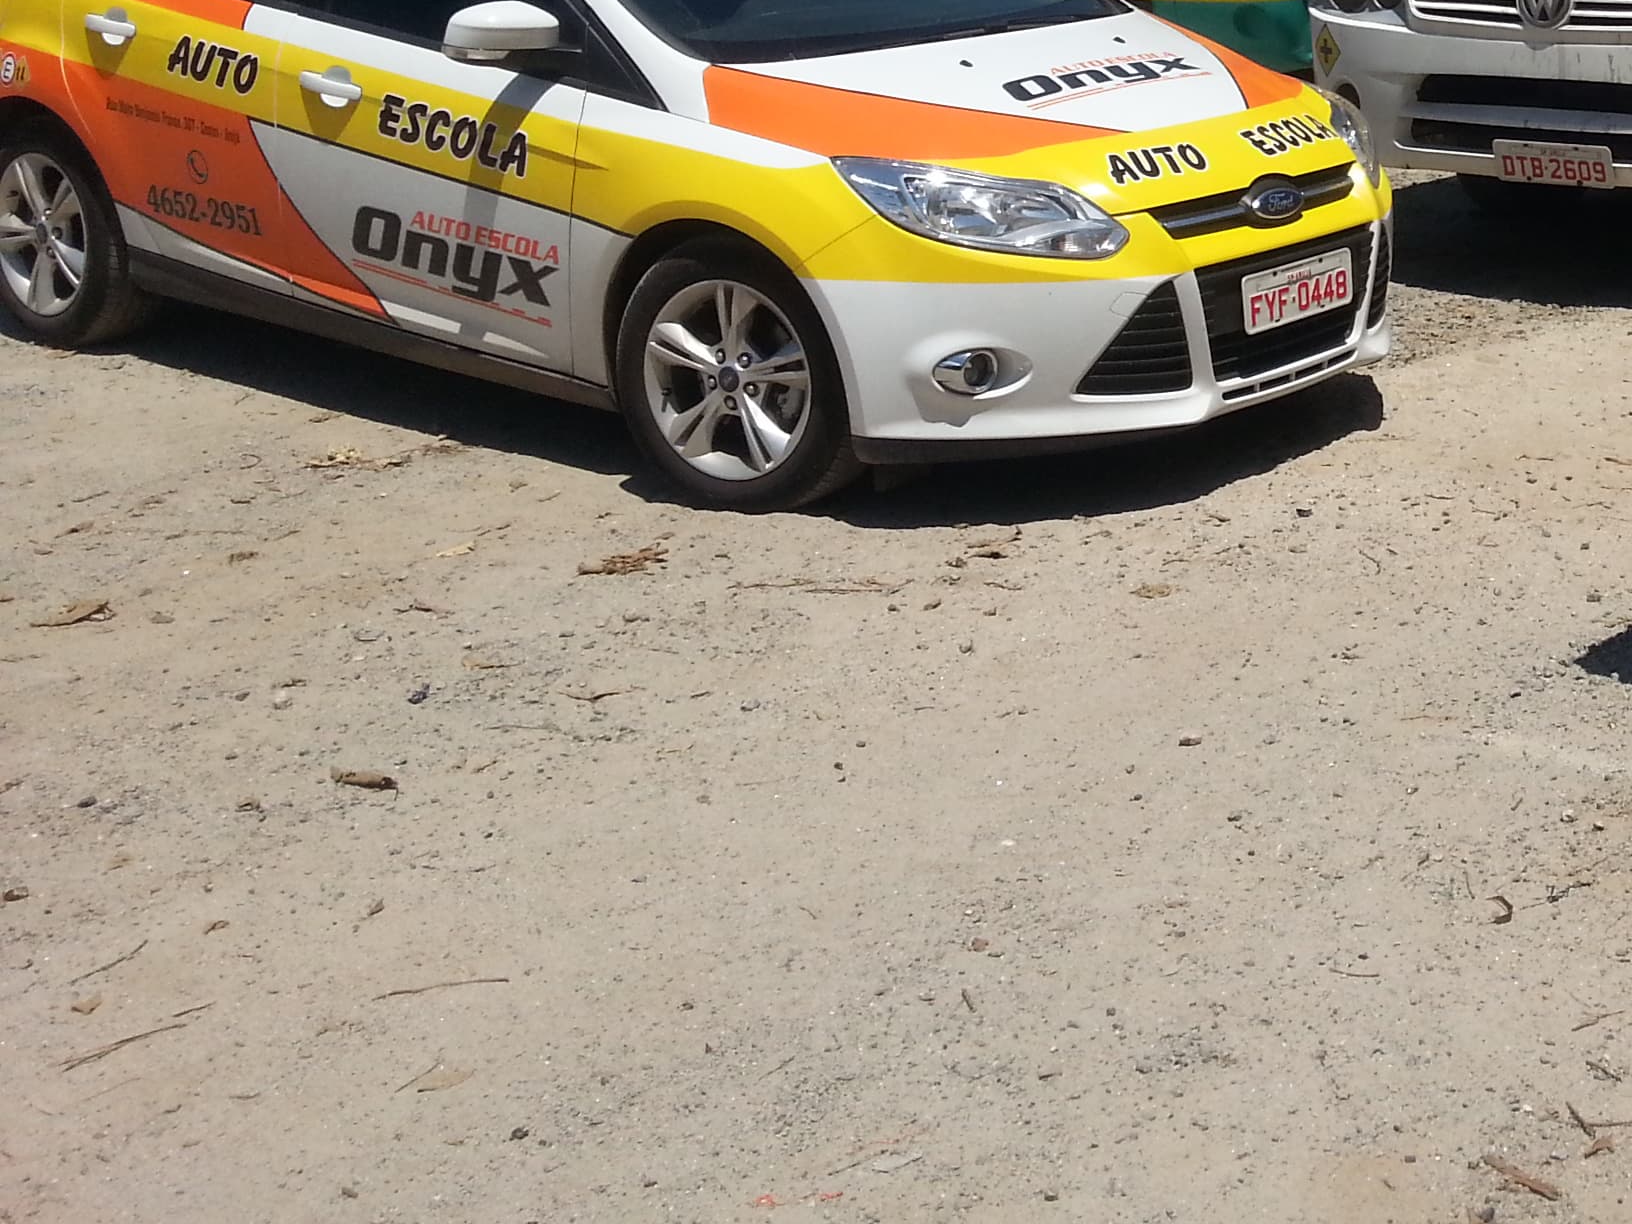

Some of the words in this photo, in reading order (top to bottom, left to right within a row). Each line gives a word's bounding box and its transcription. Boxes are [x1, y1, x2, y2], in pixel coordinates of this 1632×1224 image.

[167, 35, 258, 94] AUTO
[377, 94, 528, 178] ESCOLA
[1002, 57, 1200, 102] Onyx
[1108, 144, 1207, 185] AUTO
[1240, 114, 1339, 156] ESCOLA
[147, 184, 262, 236] 4652-2951
[410, 210, 471, 241] AUTO
[474, 229, 559, 265] ESCOLA
[352, 205, 559, 307] Onyx
